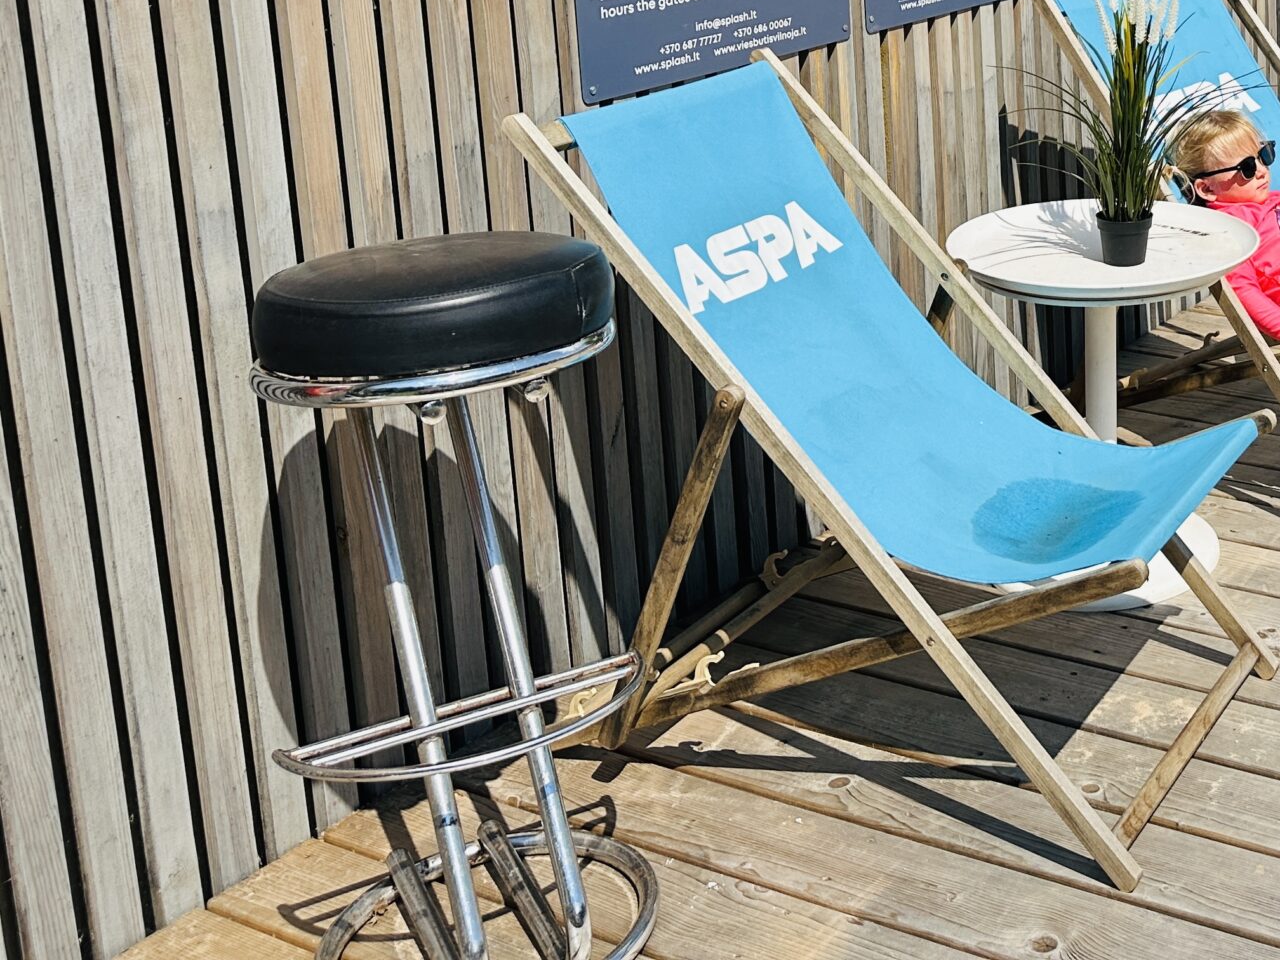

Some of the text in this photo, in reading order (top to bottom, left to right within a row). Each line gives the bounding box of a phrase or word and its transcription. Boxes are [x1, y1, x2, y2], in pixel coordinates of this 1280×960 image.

[600, 3, 634, 18] hours
[695, 10, 756, 30] info@splash.lt
[659, 17, 791, 54] +370 687 77727 +370 686 00067
[634, 52, 699, 74] www.splash.lt
[674, 201, 844, 315] ASPA
